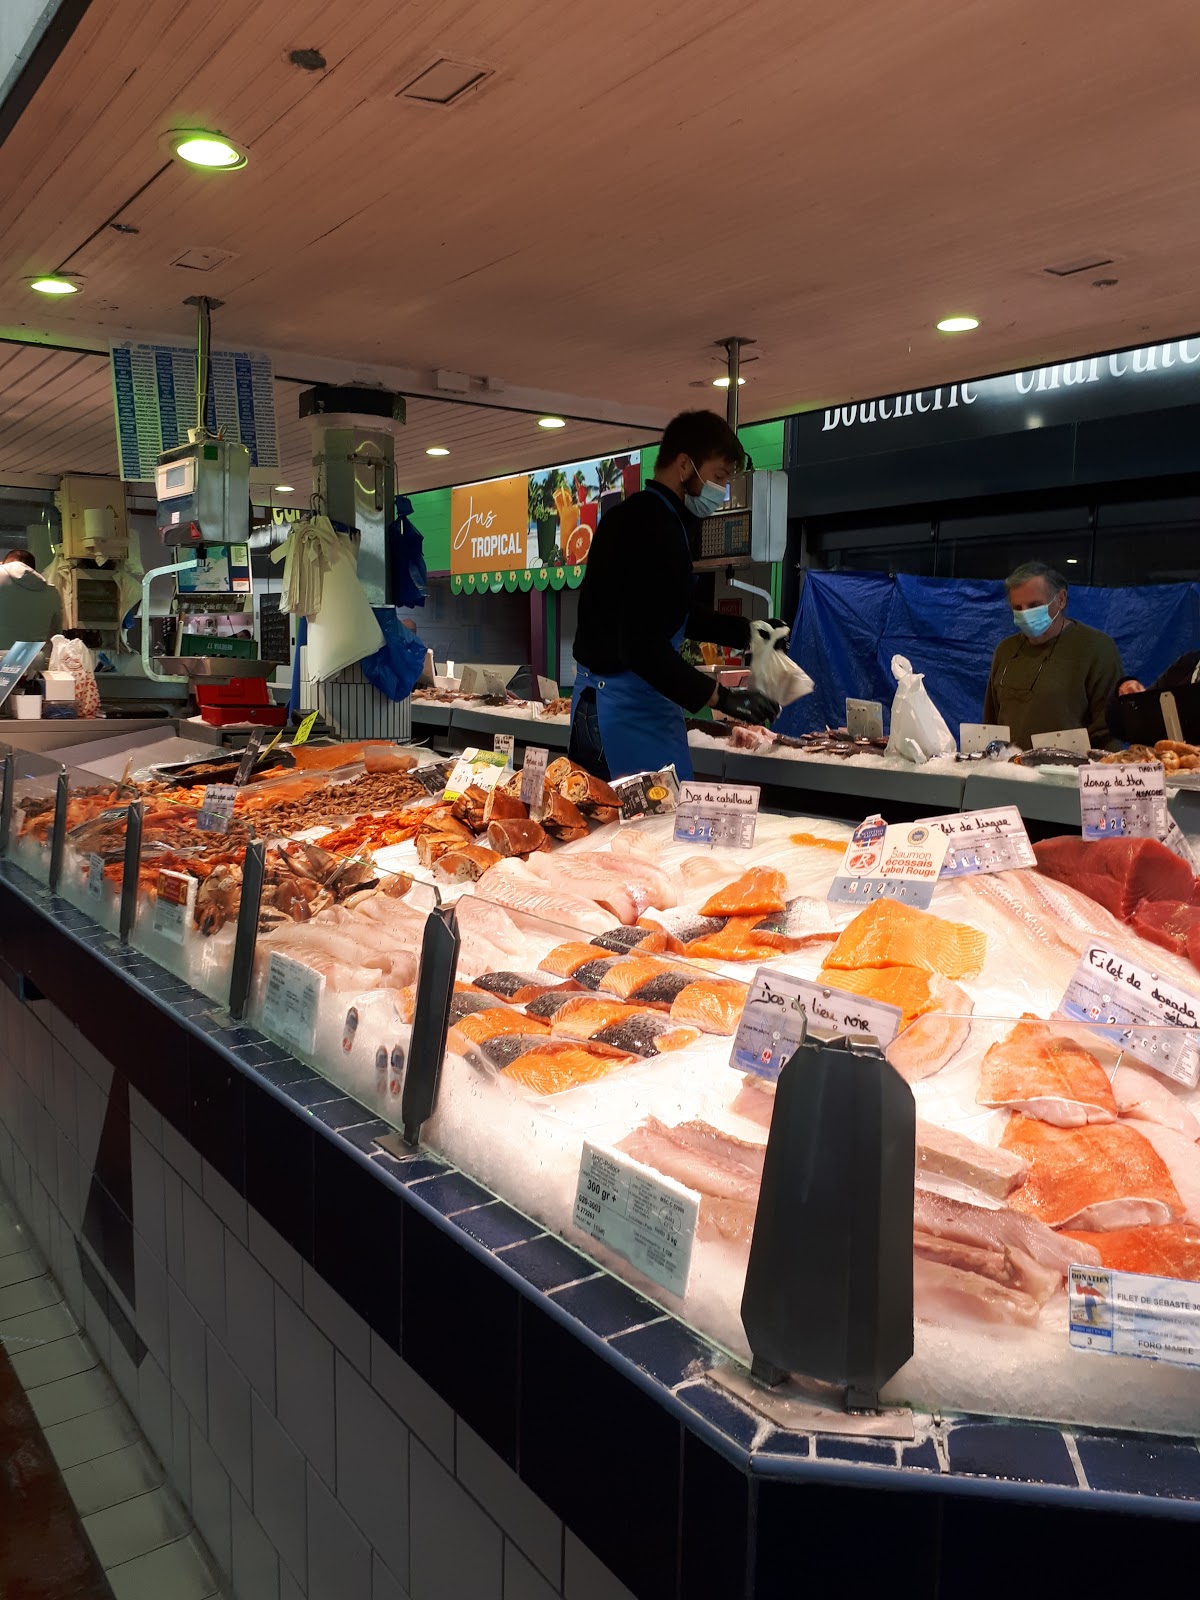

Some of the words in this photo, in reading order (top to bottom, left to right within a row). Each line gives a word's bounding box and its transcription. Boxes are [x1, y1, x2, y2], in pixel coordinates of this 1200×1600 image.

[454, 496, 497, 549] Jus
[471, 532, 522, 558] TROPICAL
[704, 792, 715, 802] de
[716, 793, 753, 805] cabillaud
[960, 821, 974, 832] de
[975, 818, 1011, 833] lingue
[890, 850, 932, 860] Saumon
[885, 858, 933, 868] écossais
[880, 866, 904, 874] Label
[905, 867, 936, 877] Rouge
[1089, 949, 1123, 980] Filet
[1126, 973, 1141, 991] de
[750, 982, 785, 1005] Dos
[811, 997, 838, 1022] lieu
[587, 1179, 600, 1195] 300
[601, 1190, 610, 1201] gr
[1071, 1272, 1110, 1284] DONATIEN
[1117, 1293, 1139, 1303] FILET
[1140, 1297, 1152, 1305] DE
[1087, 1337, 1093, 1346] 3
